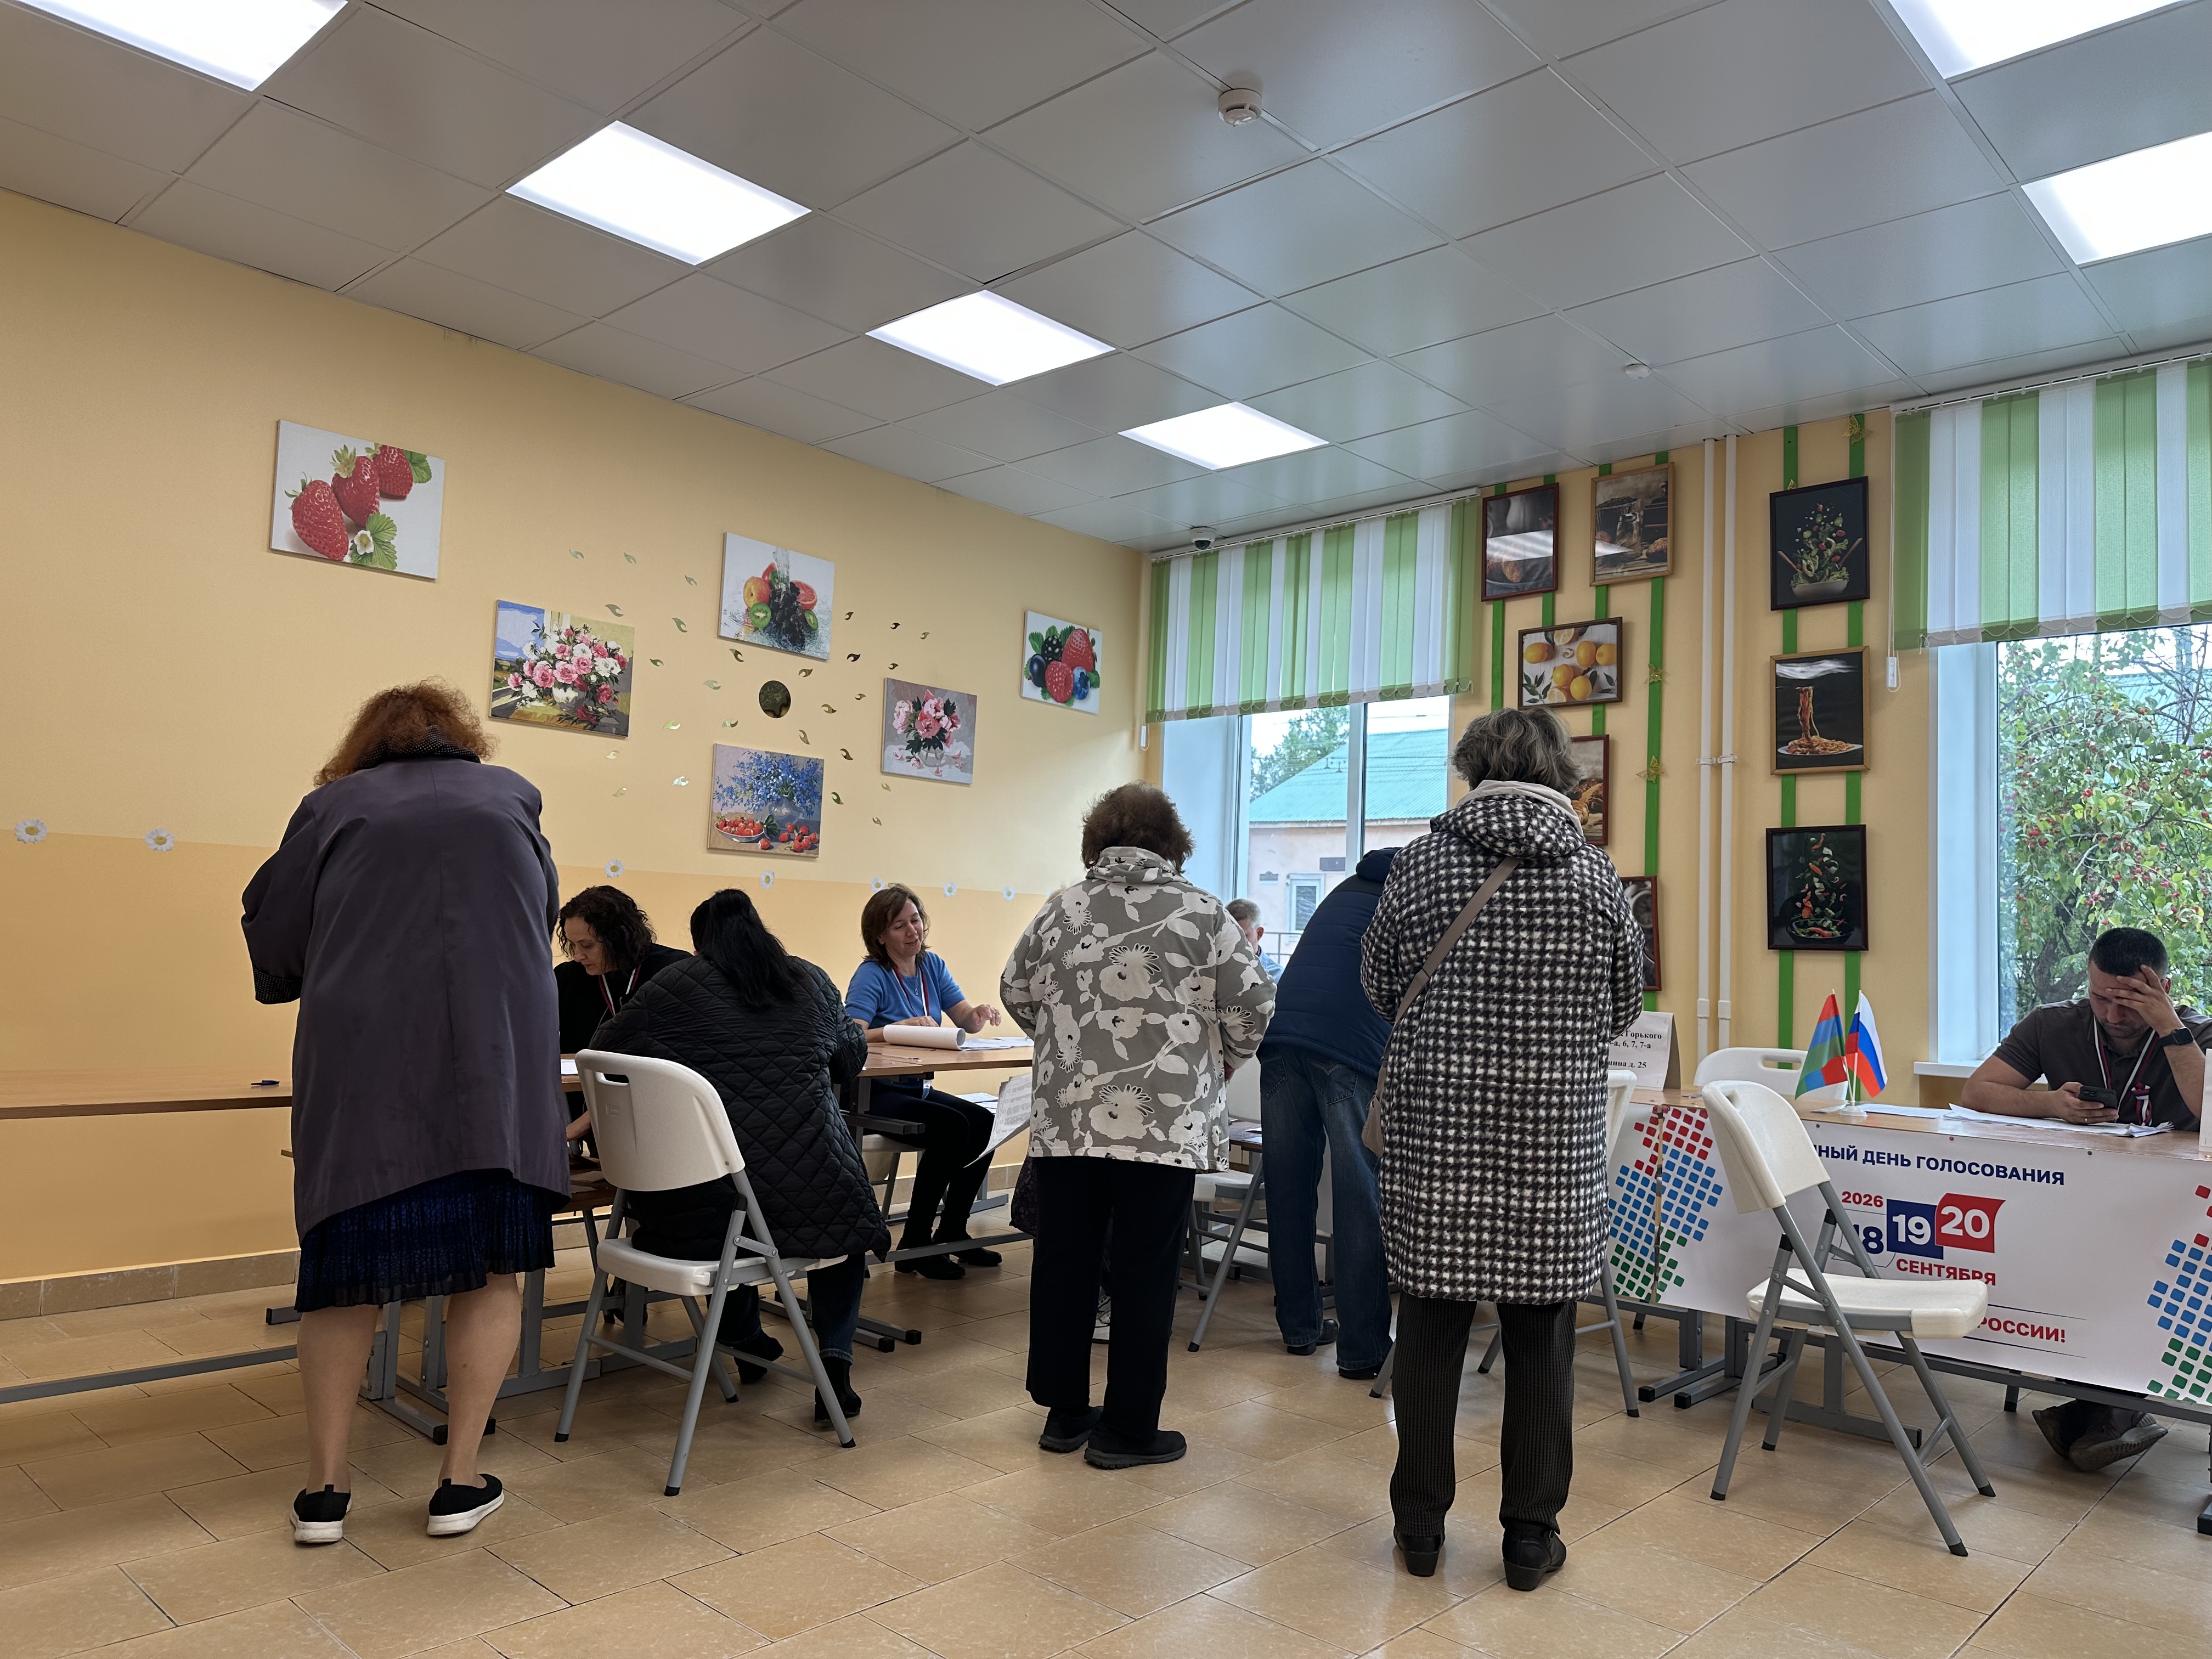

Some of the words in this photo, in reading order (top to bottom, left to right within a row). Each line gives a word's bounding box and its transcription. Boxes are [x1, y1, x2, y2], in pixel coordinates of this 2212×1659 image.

[1626, 1030, 1662, 1039] Горького
[1813, 1144, 1858, 1161] НЫЙ
[1863, 1150, 1911, 1167] ДЕНЬ
[1916, 1155, 2064, 1186] ГОЛОСОВАНИЯ
[1842, 1191, 1883, 1207] 2026
[1893, 1214, 1931, 1245] 19
[1940, 1205, 1990, 1239] 20
[1897, 1259, 1996, 1286] СЕНТЯБРЯ
